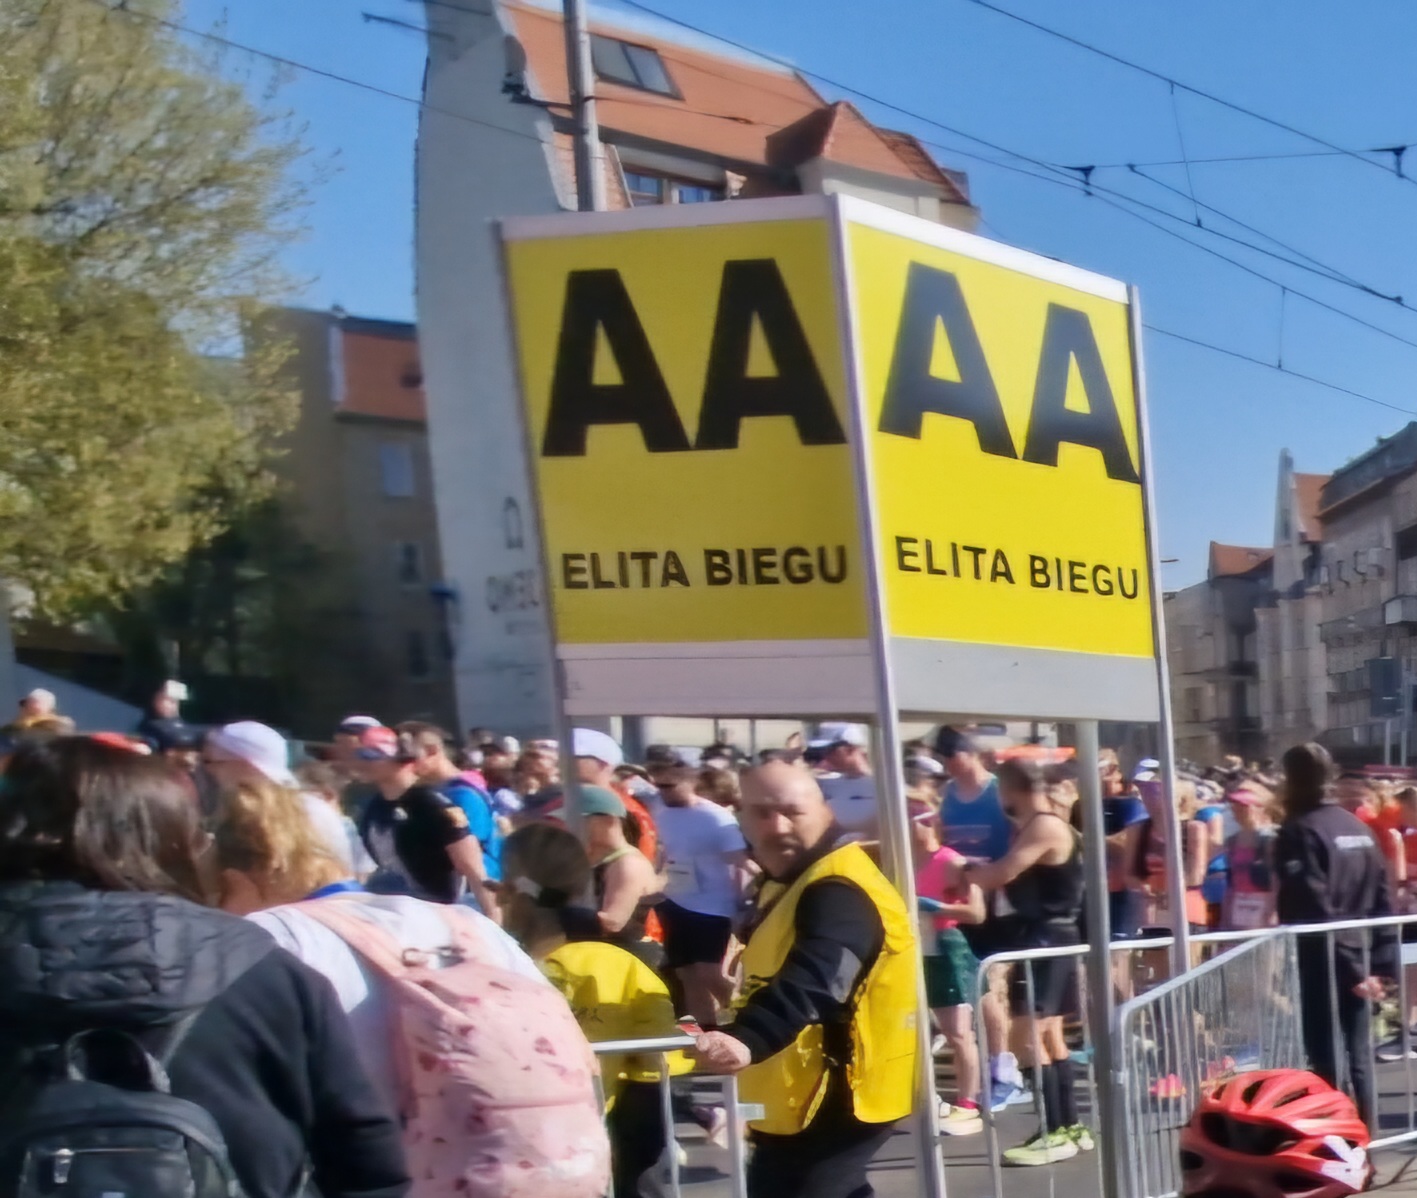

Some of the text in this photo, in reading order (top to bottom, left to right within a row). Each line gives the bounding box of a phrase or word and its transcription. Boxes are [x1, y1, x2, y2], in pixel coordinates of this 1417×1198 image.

[541, 257, 848, 457] AA
[877, 259, 1142, 486] AA
[561, 544, 848, 590] ELITA BIEGU
[895, 534, 1139, 600] ELITA BIEGU
